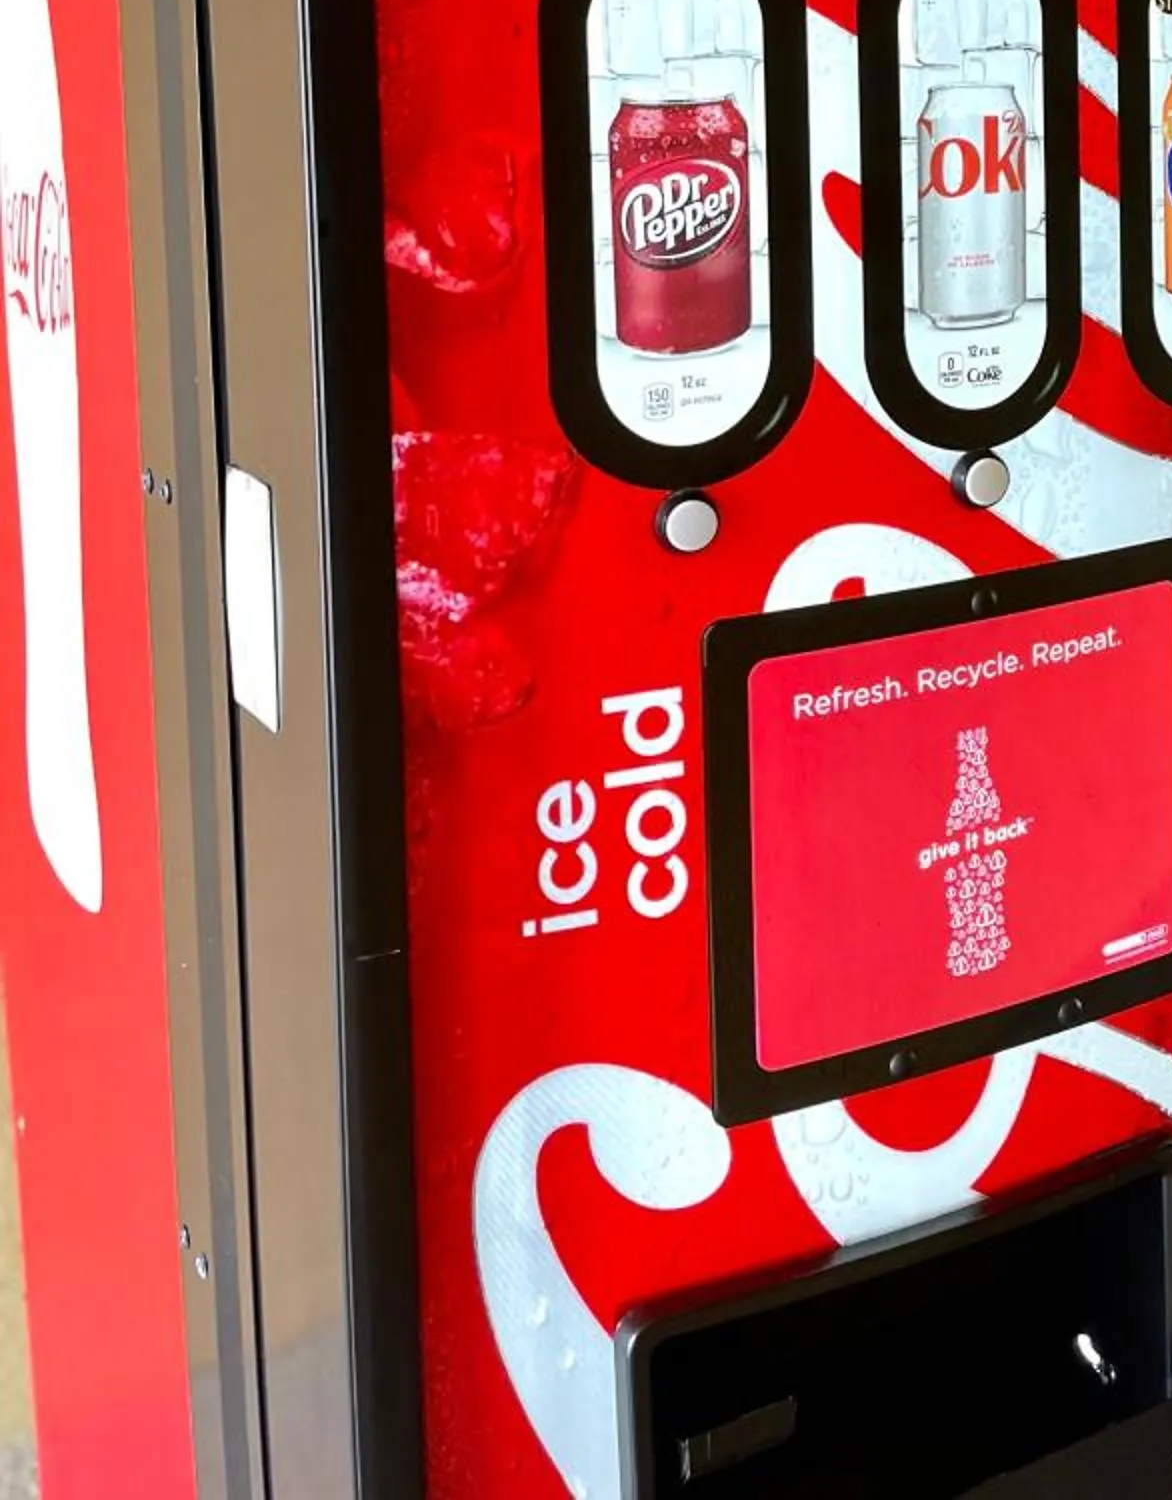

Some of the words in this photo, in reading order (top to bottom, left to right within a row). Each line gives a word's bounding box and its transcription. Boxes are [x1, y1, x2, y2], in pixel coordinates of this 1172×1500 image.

[622, 183, 733, 251] Pepper
[661, 172, 709, 214] Dr
[648, 388, 669, 402] 150
[681, 375, 693, 389] 12
[793, 675, 909, 720] Refresh.
[917, 651, 1024, 694] Recycle.
[1031, 626, 1122, 667] Repeat.
[601, 685, 689, 919] cold
[522, 779, 599, 938] ice
[919, 842, 960, 869] give
[965, 831, 979, 852] it
[983, 816, 1028, 846] back
